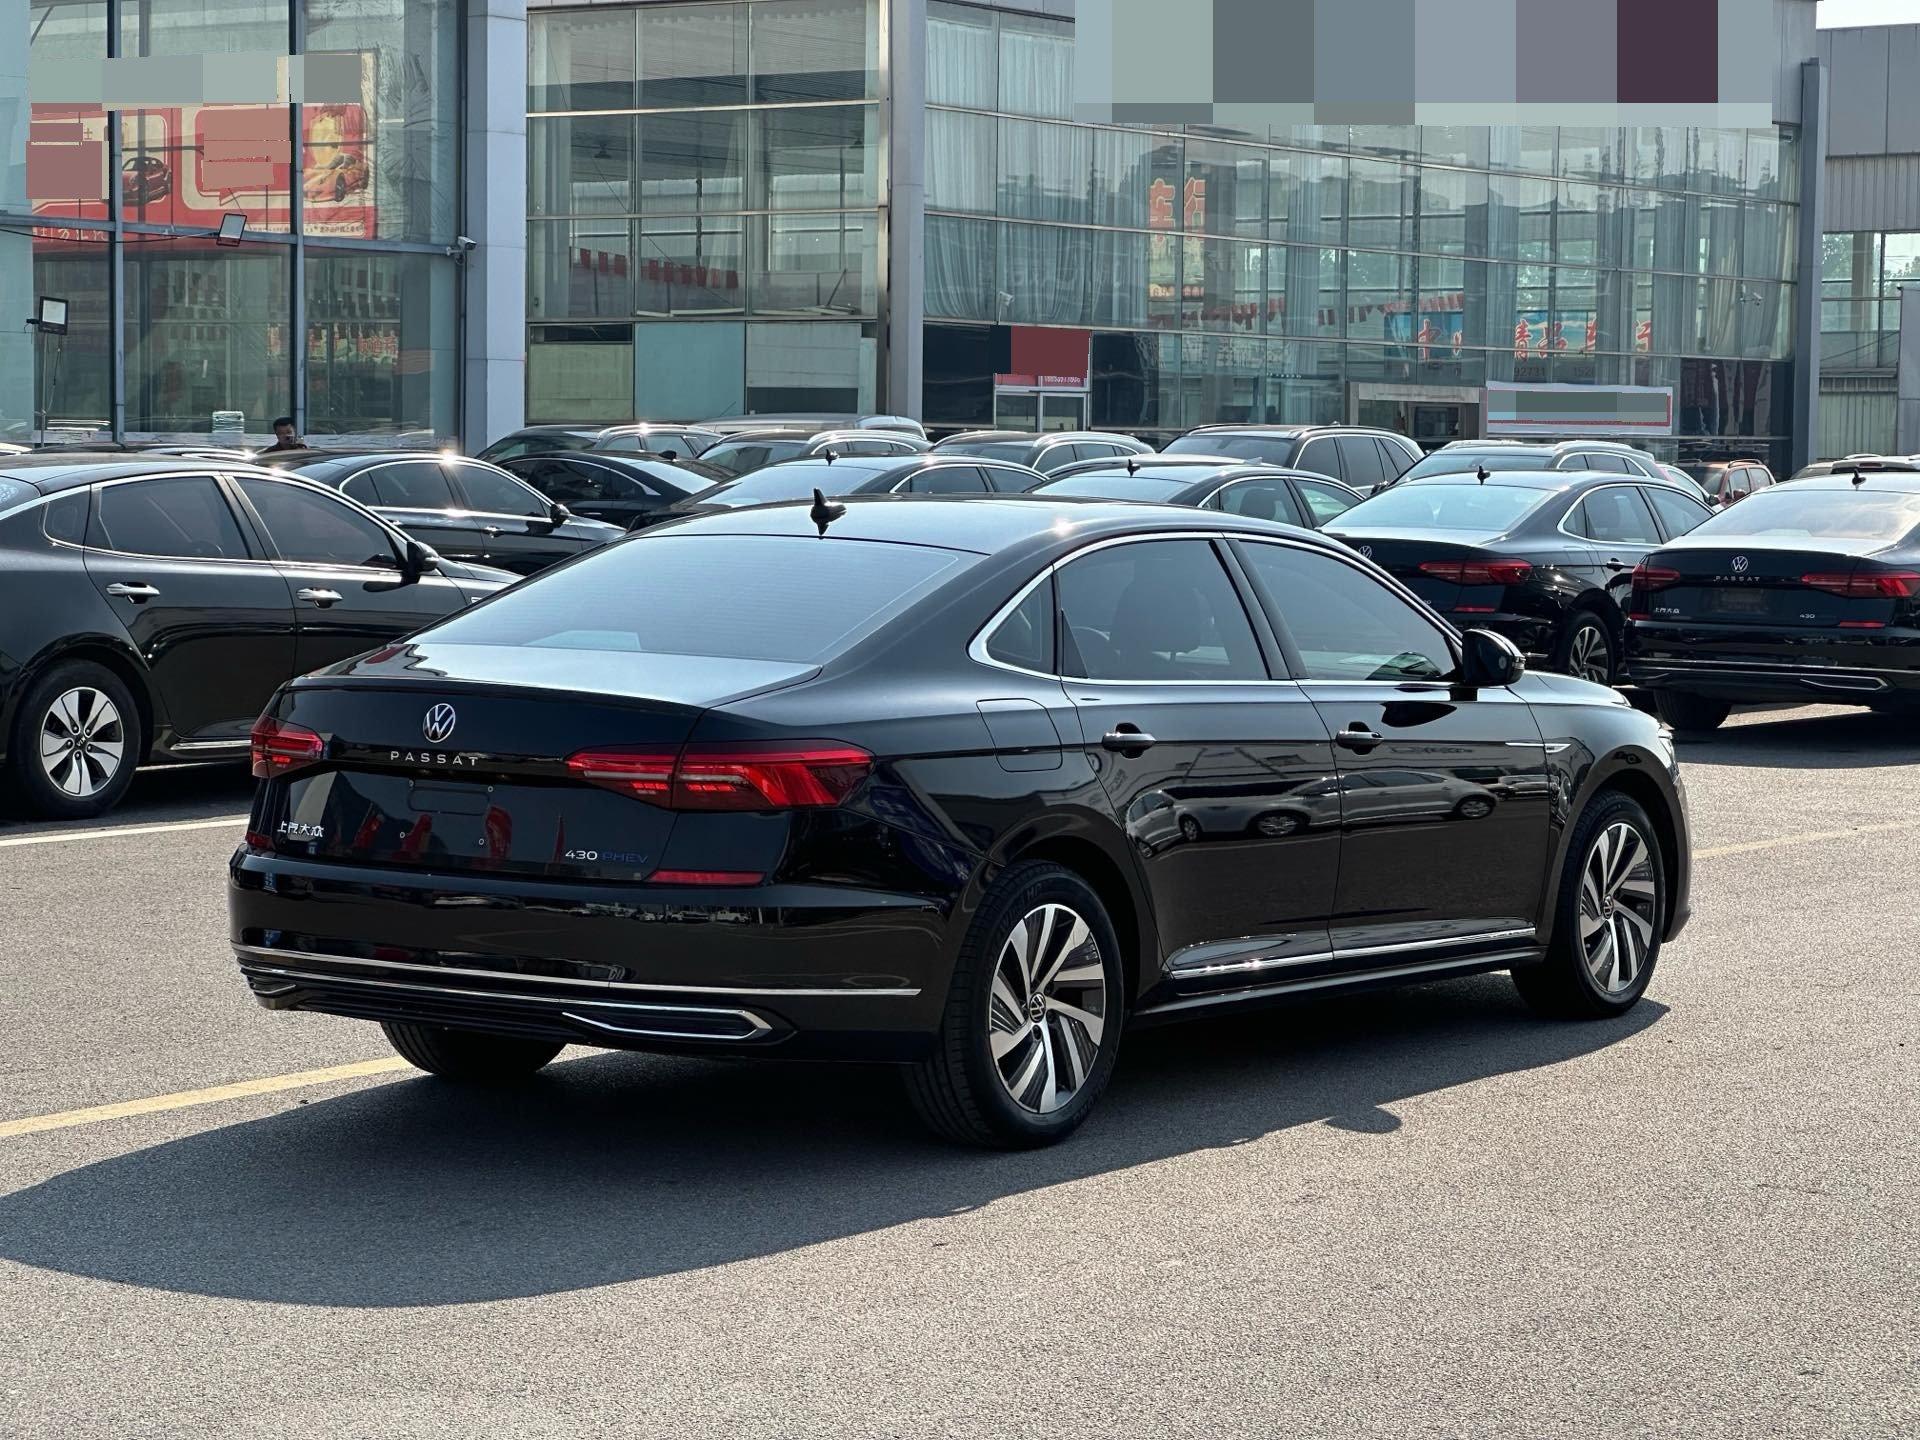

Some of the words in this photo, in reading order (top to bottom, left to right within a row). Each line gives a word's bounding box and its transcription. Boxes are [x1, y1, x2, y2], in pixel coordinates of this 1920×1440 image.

[390, 751, 479, 766] PASSAT
[277, 820, 325, 837] 上汽大众
[565, 850, 598, 861] 430
[602, 851, 649, 864] PHEV
